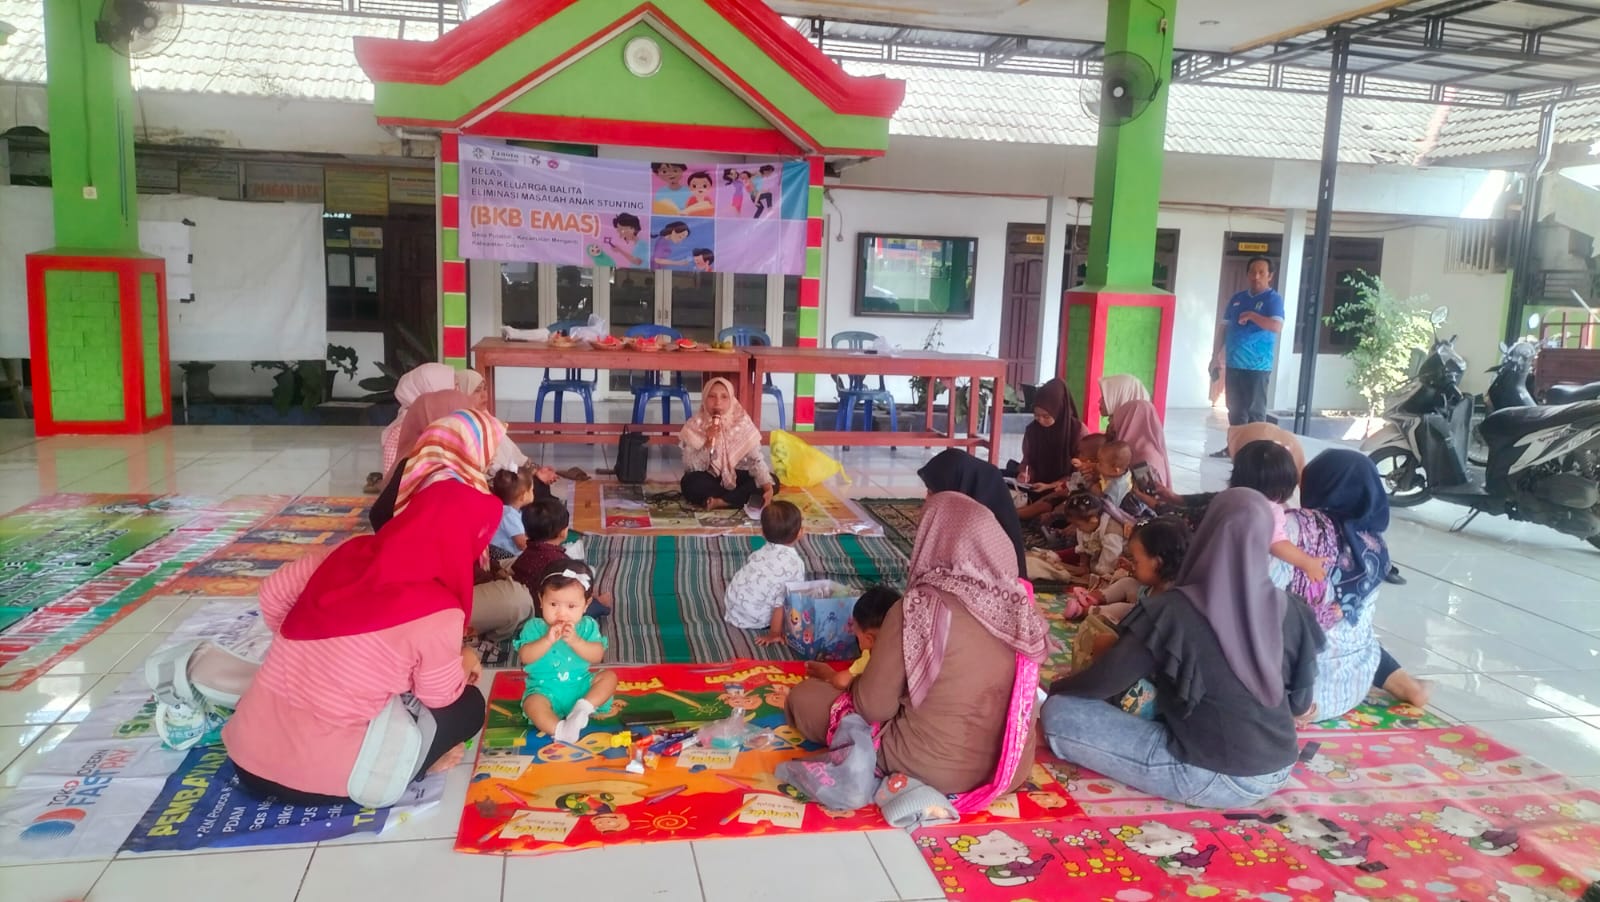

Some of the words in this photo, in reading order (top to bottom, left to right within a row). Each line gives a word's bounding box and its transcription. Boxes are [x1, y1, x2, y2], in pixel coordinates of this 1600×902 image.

[471, 167, 502, 177] KELAS
[471, 178, 495, 187] BINA
[497, 179, 548, 192] KELUARGA
[550, 185, 582, 195] BALITA
[471, 188, 520, 200] ELIMINASI
[521, 193, 567, 204] MASALAH
[568, 197, 595, 206] ANAK
[597, 199, 644, 210] STUNTING
[470, 205, 523, 229] (BKB
[530, 209, 599, 238] EMAS)
[46, 780, 80, 807] TOKO
[75, 749, 110, 777] ODERN
[65, 748, 137, 807] FASTPAY
[146, 743, 228, 837] PEMBAYARA
[222, 806, 247, 833] PDAM
[249, 812, 268, 831] Gas
